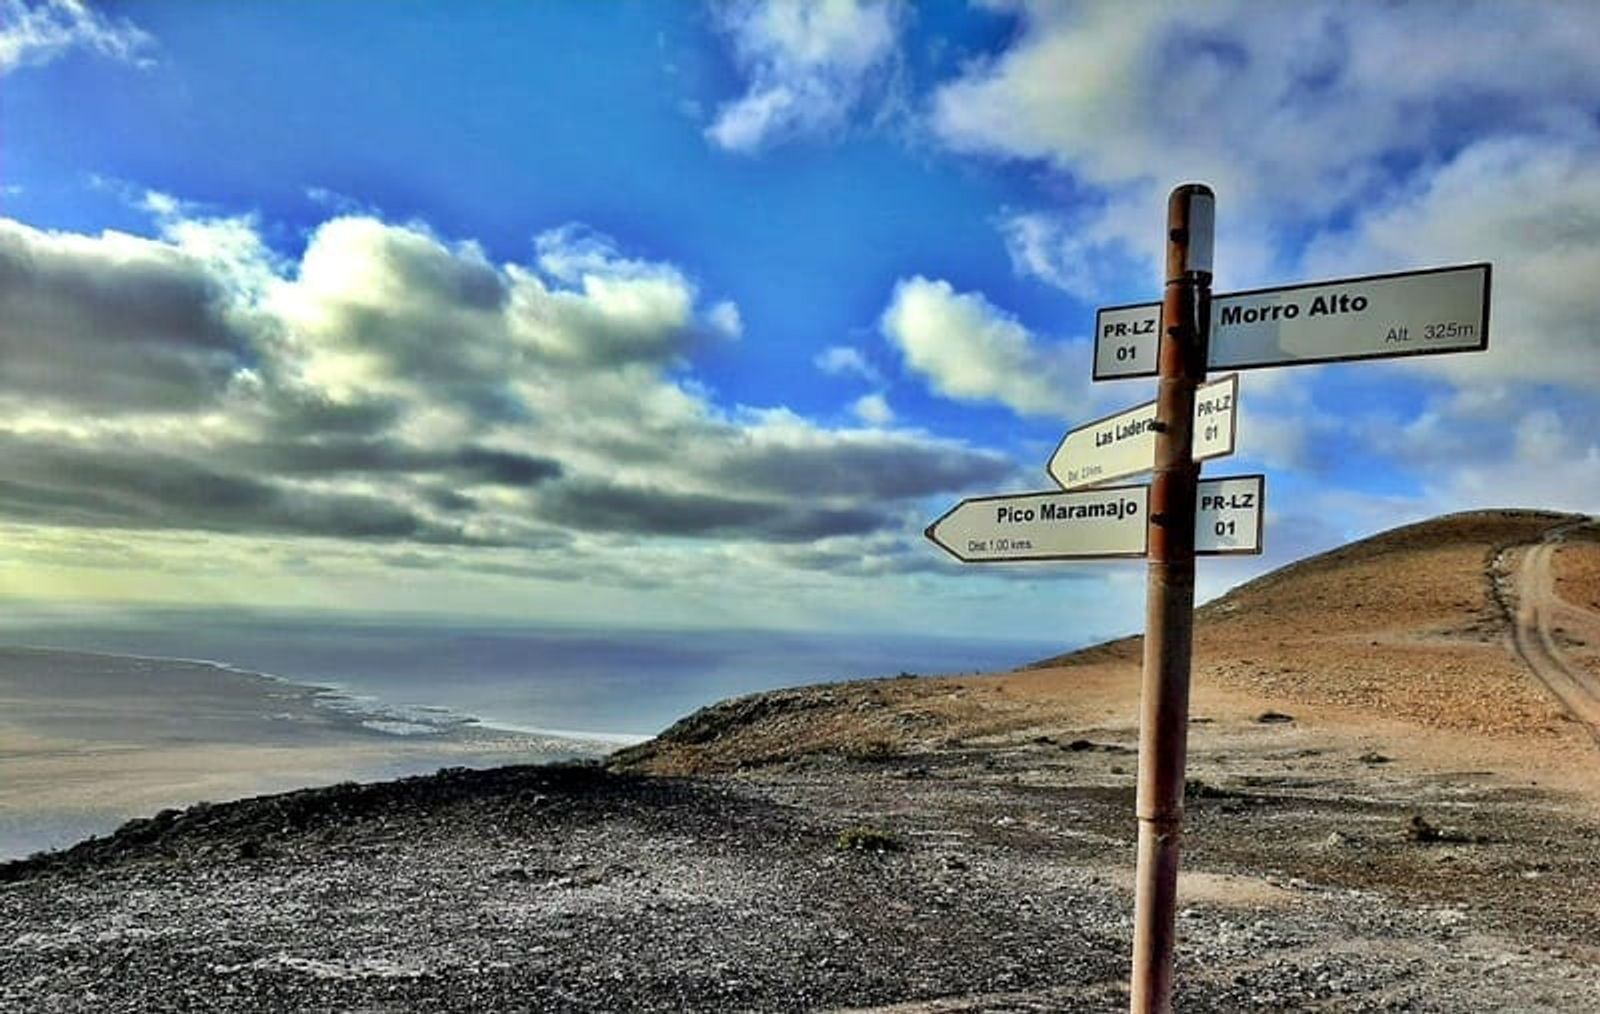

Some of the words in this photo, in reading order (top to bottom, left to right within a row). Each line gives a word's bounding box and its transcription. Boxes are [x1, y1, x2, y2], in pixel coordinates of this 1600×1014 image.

[1220, 303, 1300, 326] Morro
[1309, 295, 1368, 316] Alto
[1104, 319, 1156, 338] PR-LZ
[1116, 346, 1136, 361] 01
[1198, 395, 1232, 417] PR-LZ
[1096, 431, 1114, 447] Las
[1116, 418, 1157, 441] Ladera
[1204, 426, 1218, 441] 01
[997, 506, 1035, 523] Pico
[1040, 498, 1138, 520] Maramajo
[1201, 494, 1254, 511] PR-LZ
[1215, 522, 1236, 536] 01
